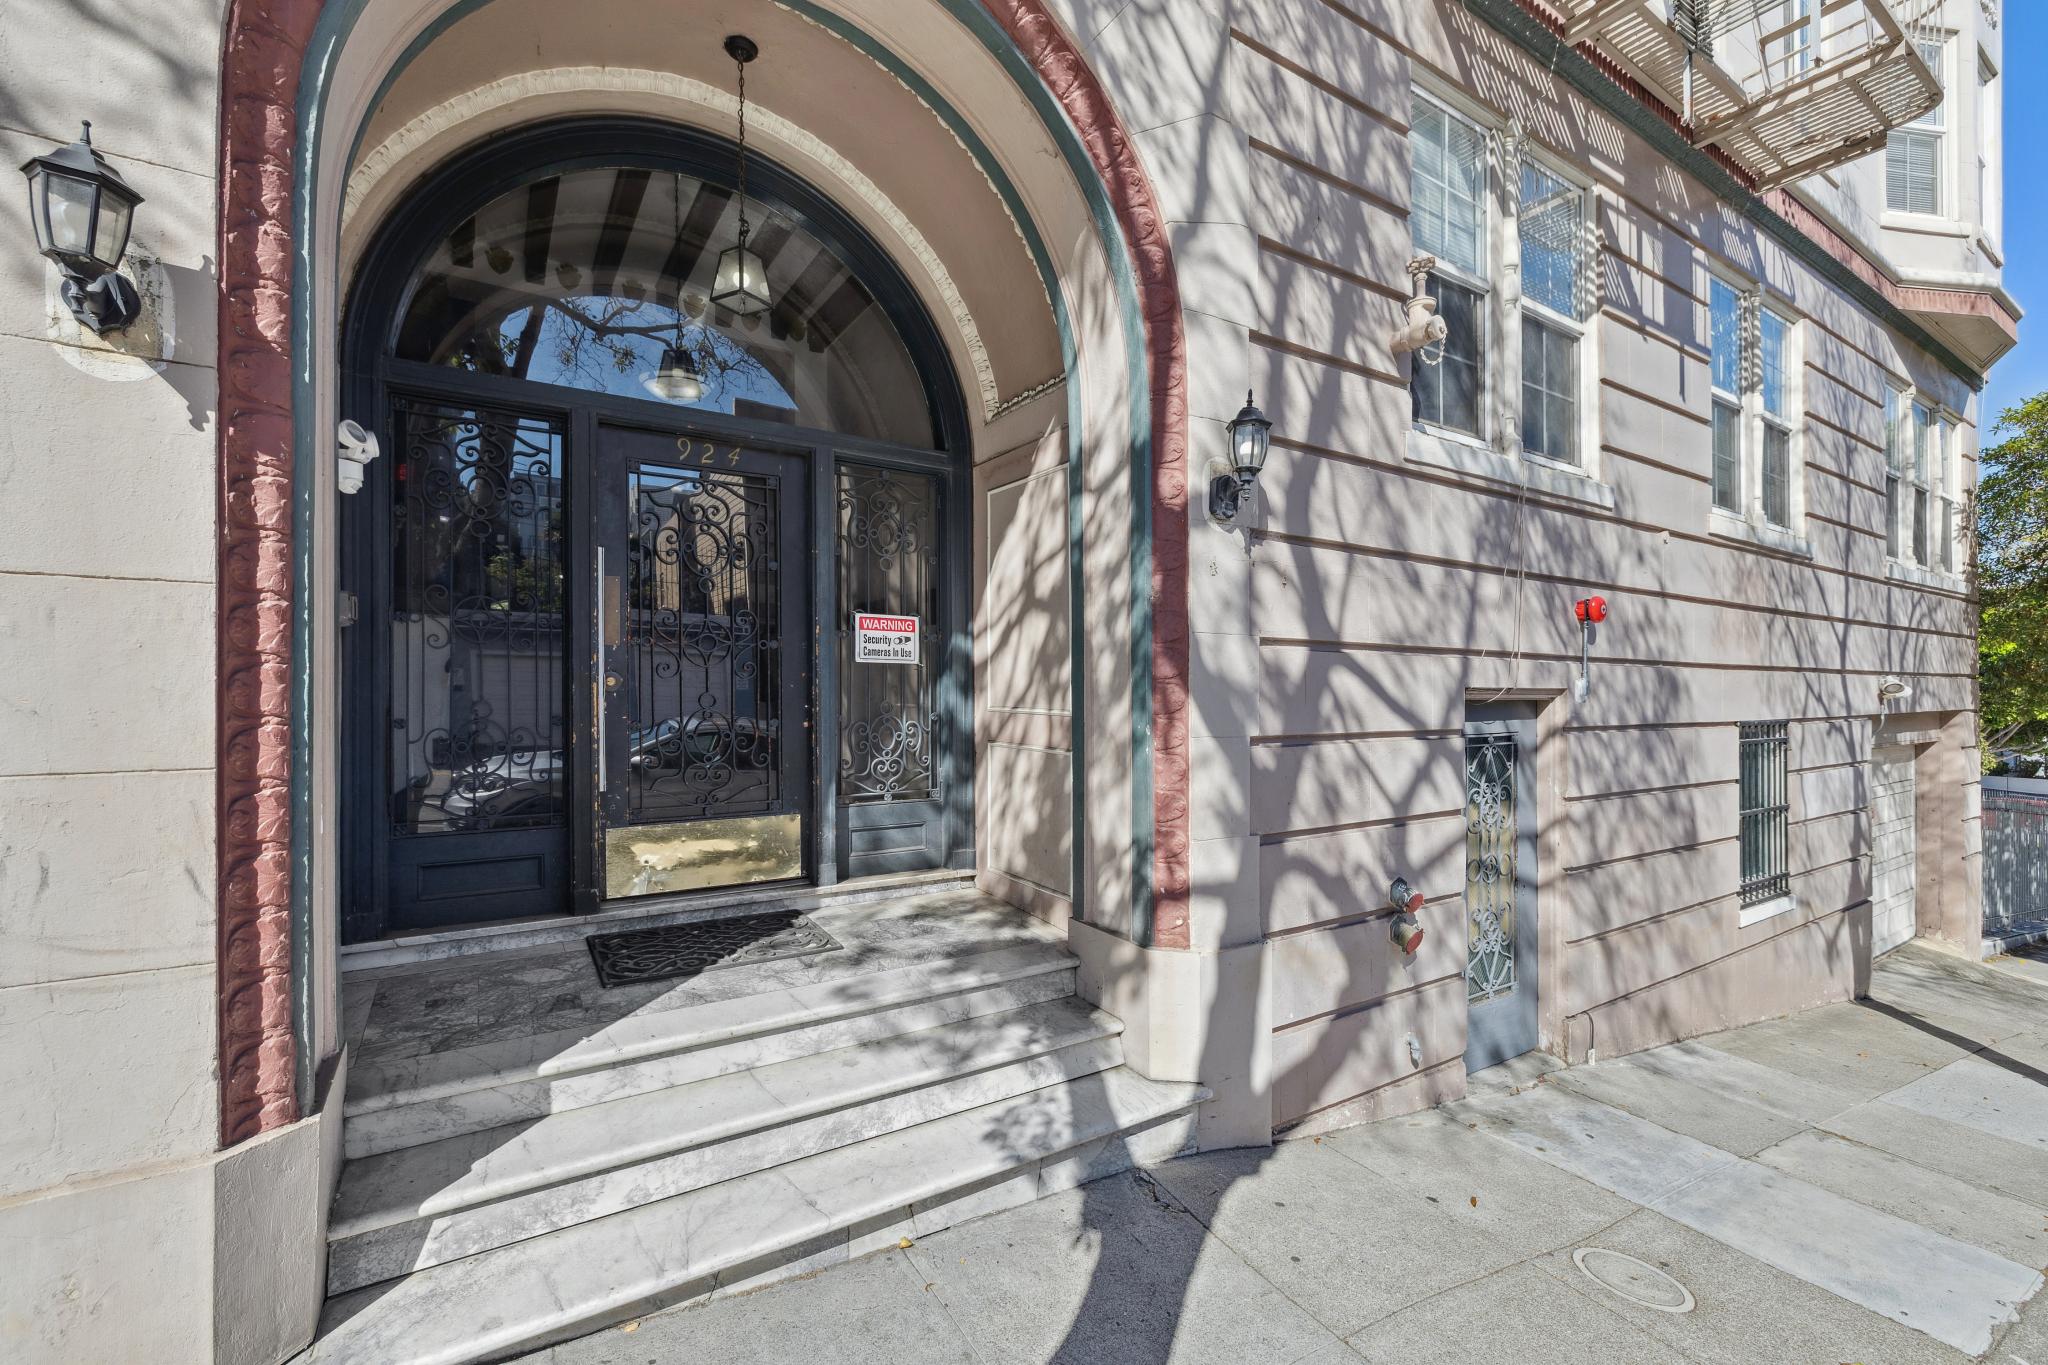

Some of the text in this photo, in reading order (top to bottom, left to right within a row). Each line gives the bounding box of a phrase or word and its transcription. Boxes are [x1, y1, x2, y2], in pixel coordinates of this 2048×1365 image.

[677, 437, 741, 467] 924
[862, 618, 913, 631] WARNING
[863, 634, 892, 646] Security
[863, 646, 912, 658] Cameras In Use
